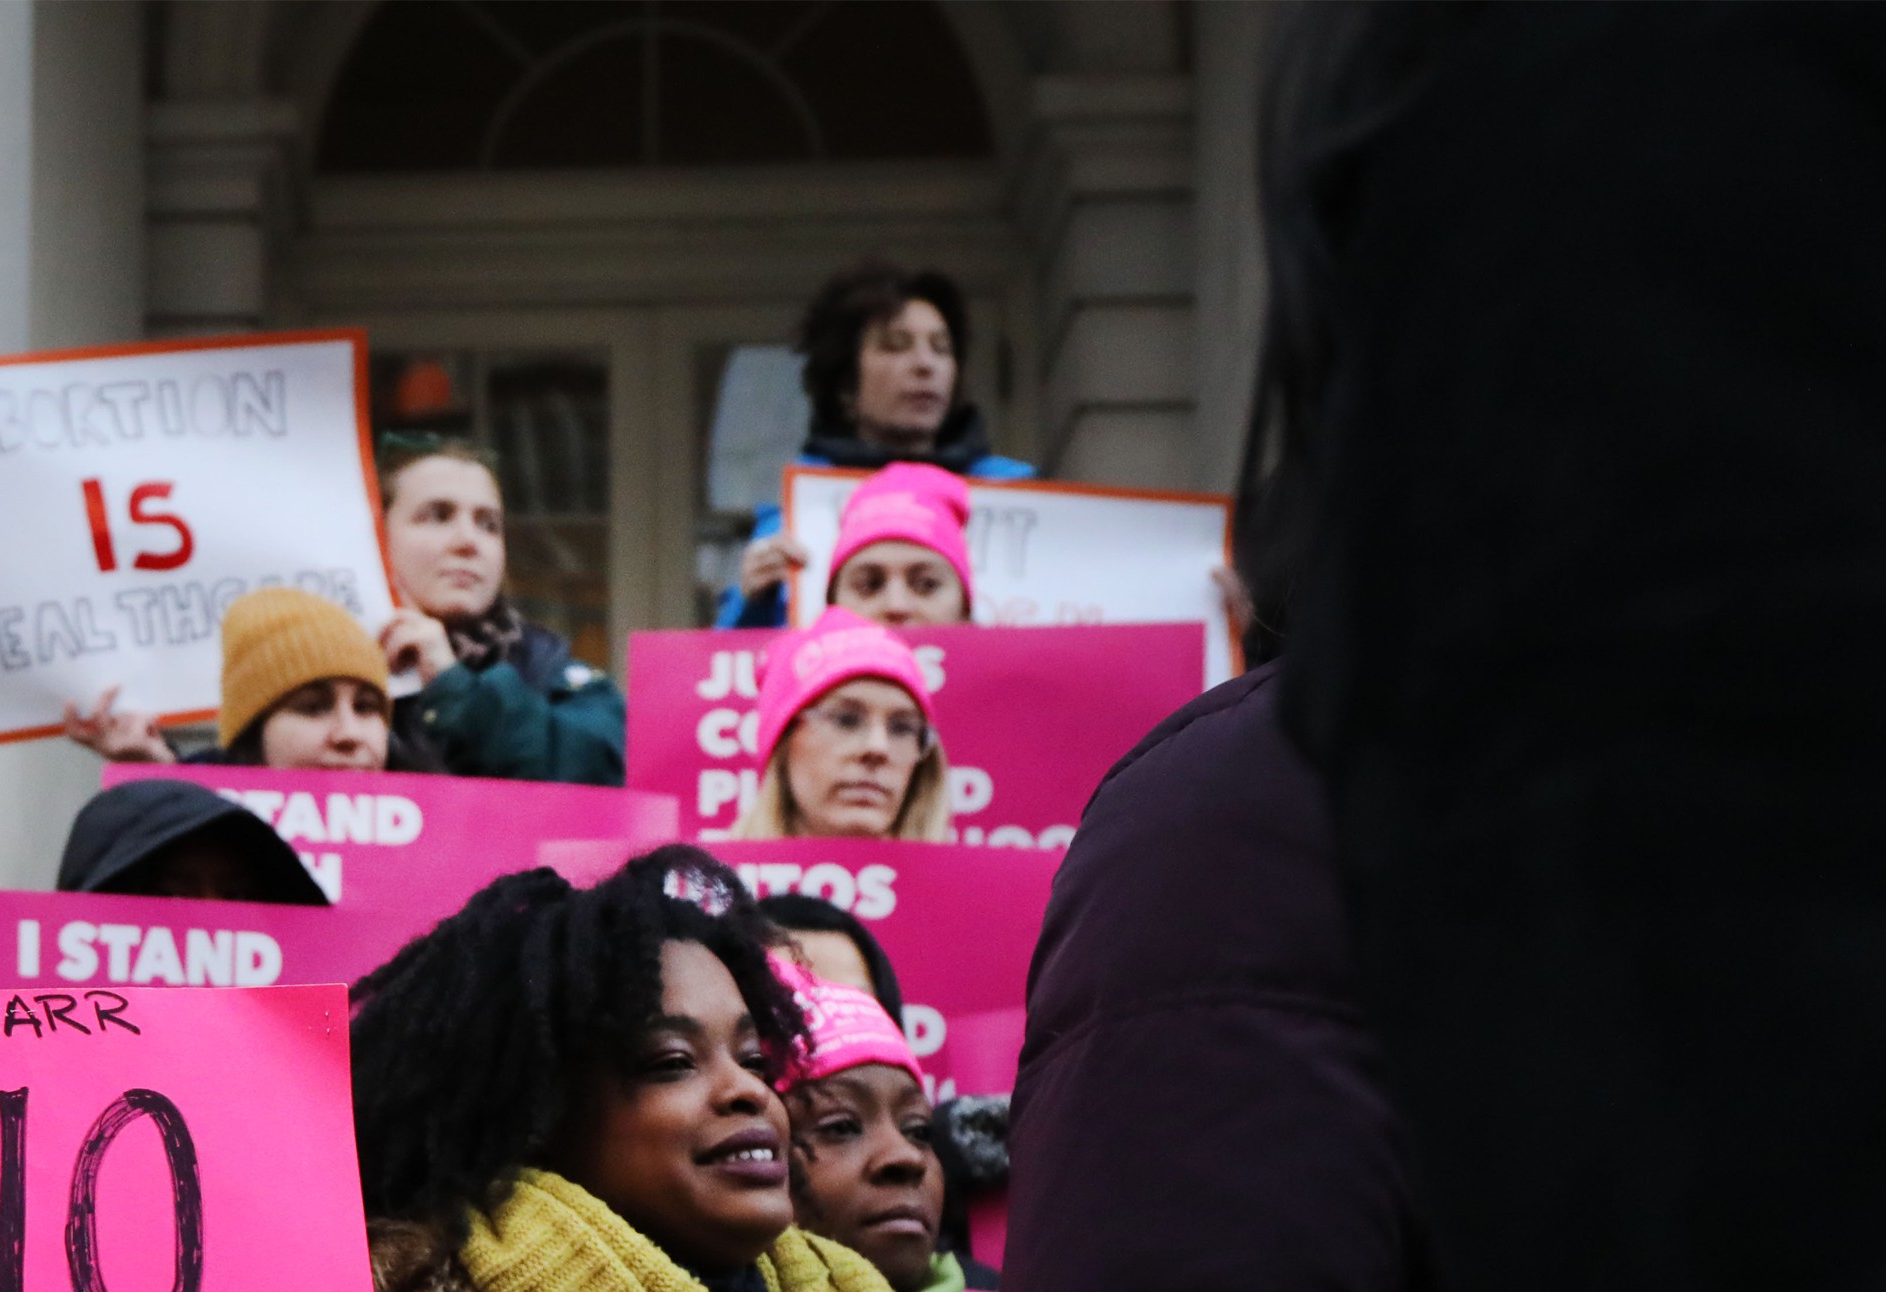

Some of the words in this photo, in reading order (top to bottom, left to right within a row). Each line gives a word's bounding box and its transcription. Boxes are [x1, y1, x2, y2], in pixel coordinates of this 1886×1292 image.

[81, 477, 194, 573] IS
[216, 787, 424, 847] TAND
[736, 862, 898, 920] TOS
[17, 919, 41, 978] I
[57, 921, 284, 987] STAND
